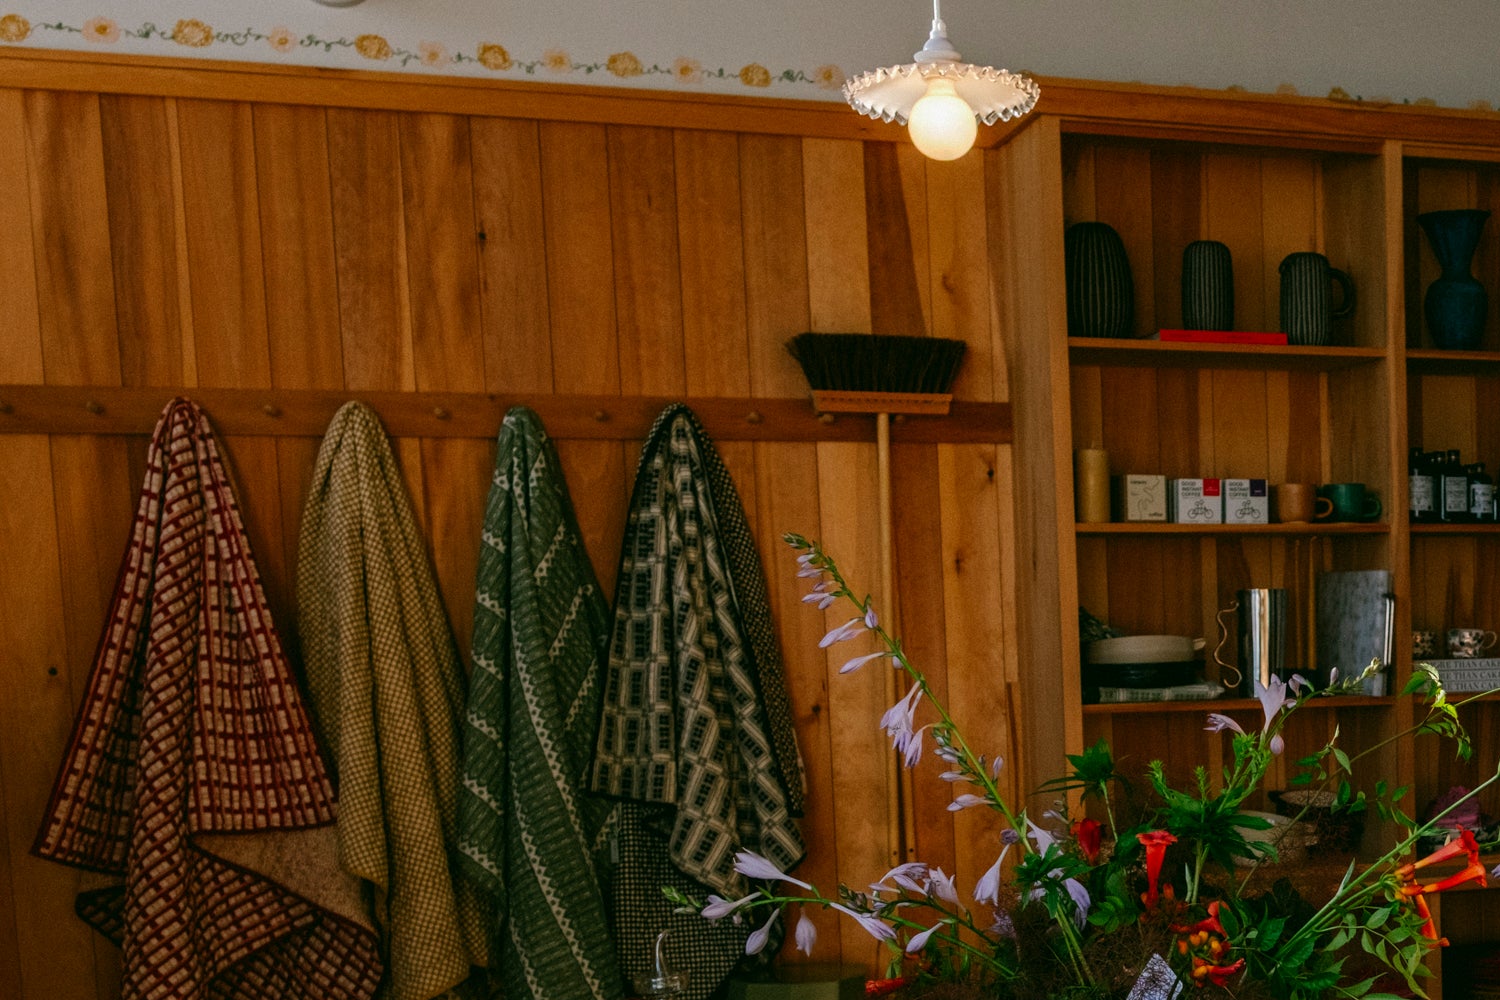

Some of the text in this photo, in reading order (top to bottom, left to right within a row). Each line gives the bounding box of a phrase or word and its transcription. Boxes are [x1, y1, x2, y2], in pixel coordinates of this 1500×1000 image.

[1454, 661, 1478, 669] THAN
[1454, 671, 1478, 679] THAN
[1455, 682, 1478, 690] THAN
